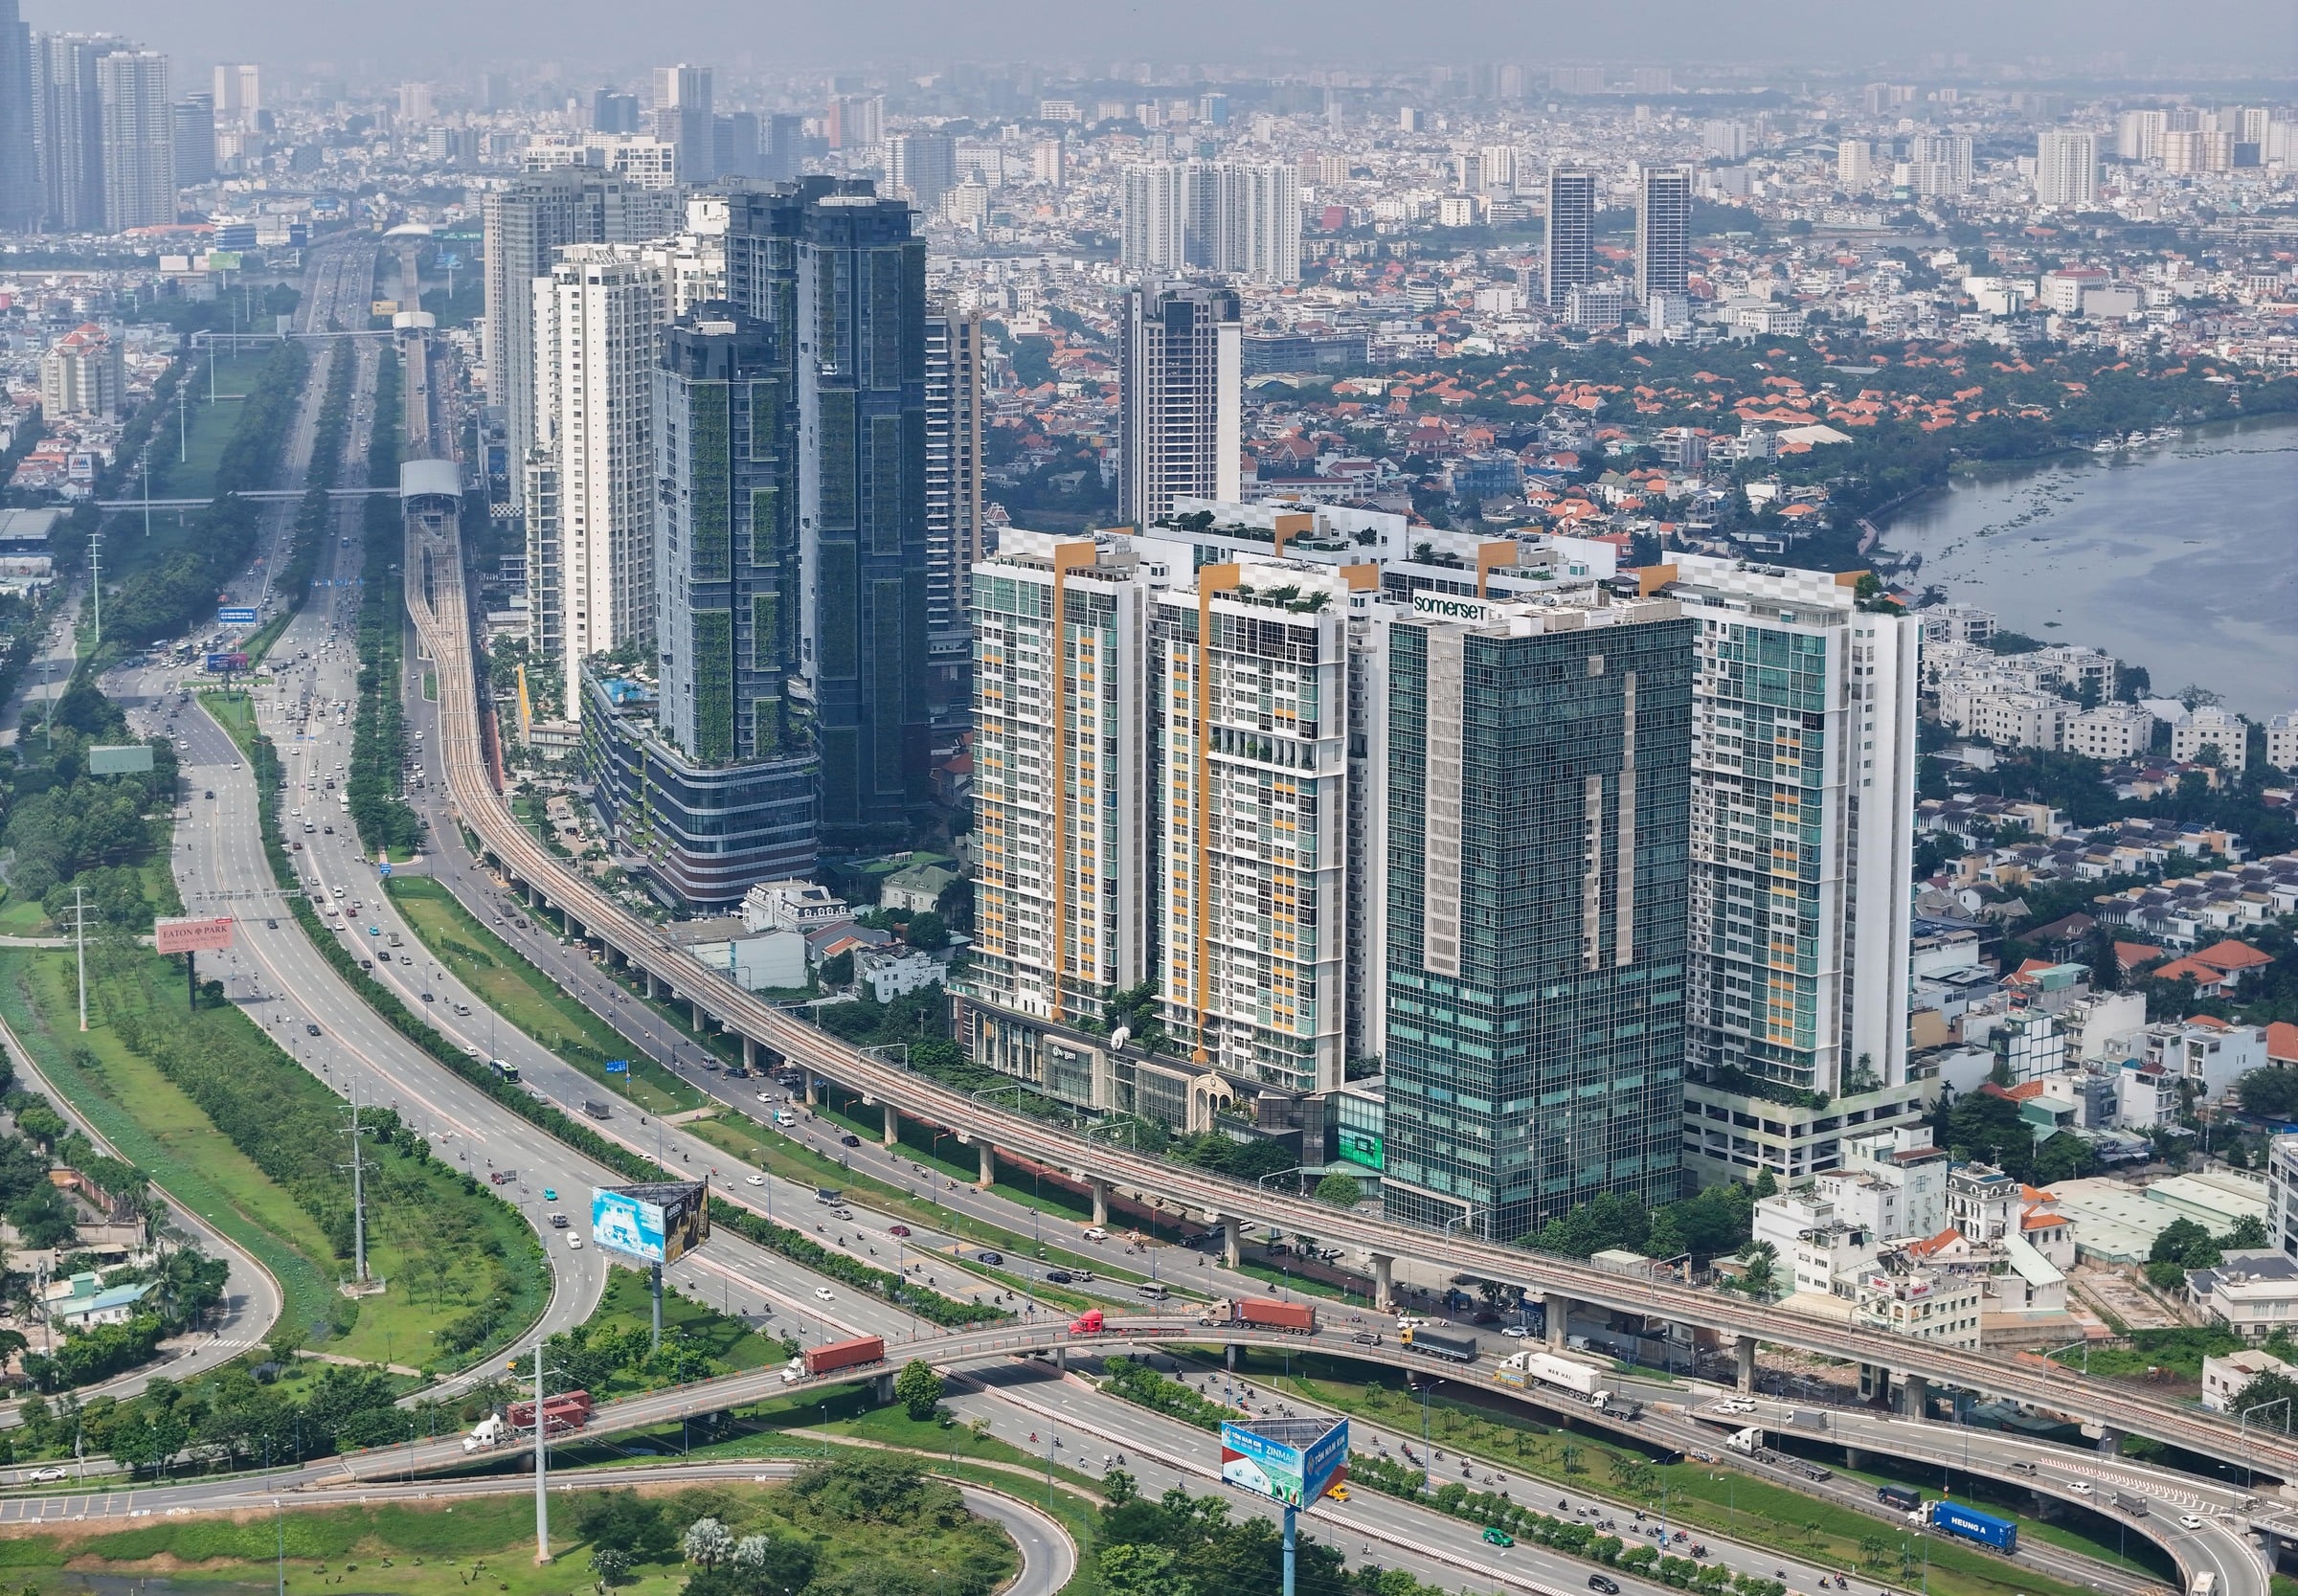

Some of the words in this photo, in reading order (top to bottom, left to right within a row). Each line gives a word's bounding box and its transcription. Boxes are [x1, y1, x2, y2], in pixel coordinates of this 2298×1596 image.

[163, 928, 193, 938] EATON
[204, 926, 228, 934] PARK
[1561, 1372, 1572, 1381] HAI
[1242, 1435, 1252, 1445] NAM
[1325, 1442, 1336, 1457] NAM
[1950, 1516, 1979, 1532] HEUNG
[1979, 1526, 1987, 1535] A
